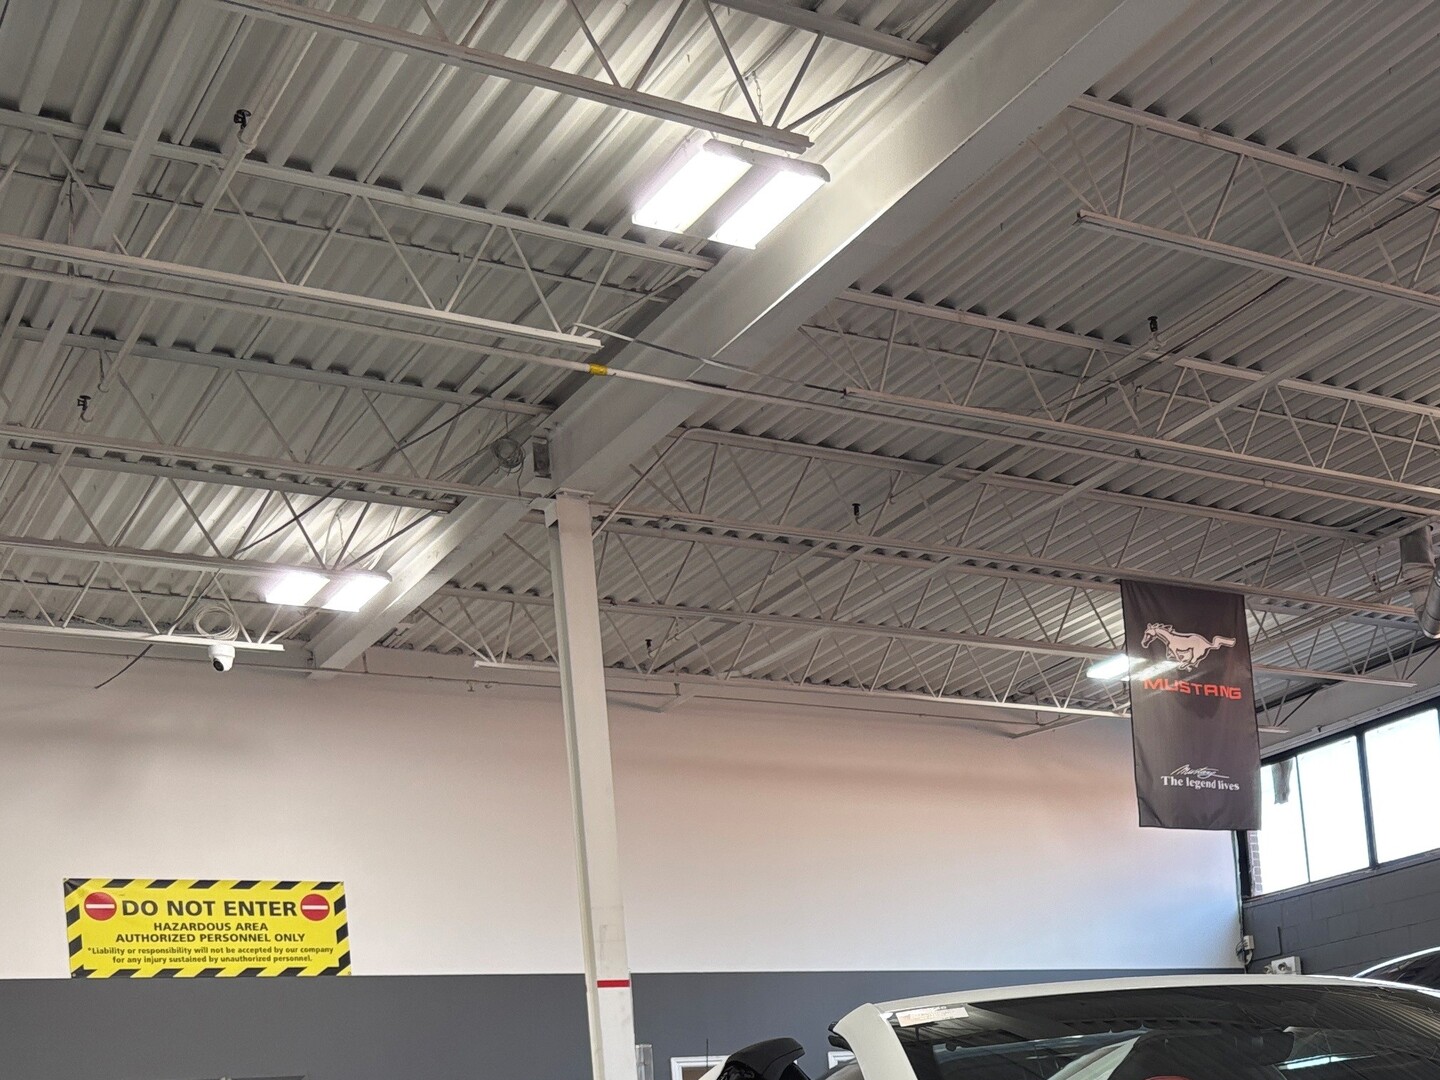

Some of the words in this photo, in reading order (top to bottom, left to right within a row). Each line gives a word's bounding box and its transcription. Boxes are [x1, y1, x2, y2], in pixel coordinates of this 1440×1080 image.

[1143, 678, 1242, 700] MUSTANG
[1160, 775, 1184, 786] The
[1185, 777, 1216, 790] legend
[1217, 780, 1240, 791] lives
[122, 900, 158, 916] DO
[167, 900, 216, 917] NOT
[223, 900, 298, 917] ENTER
[154, 922, 232, 931] HAZARDOUS
[235, 922, 269, 931] AREA
[115, 933, 196, 942] AUTHORIZED
[199, 933, 271, 942] PERSONNEL
[274, 933, 306, 942] ONLY
[138, 947, 192, 955] responsibility
[237, 947, 272, 955] accepted
[274, 947, 283, 955] by
[300, 947, 334, 955] company
[126, 957, 142, 965] any
[144, 956, 167, 965] injury
[208, 956, 219, 964] by
[220, 955, 271, 963] unauthorized
